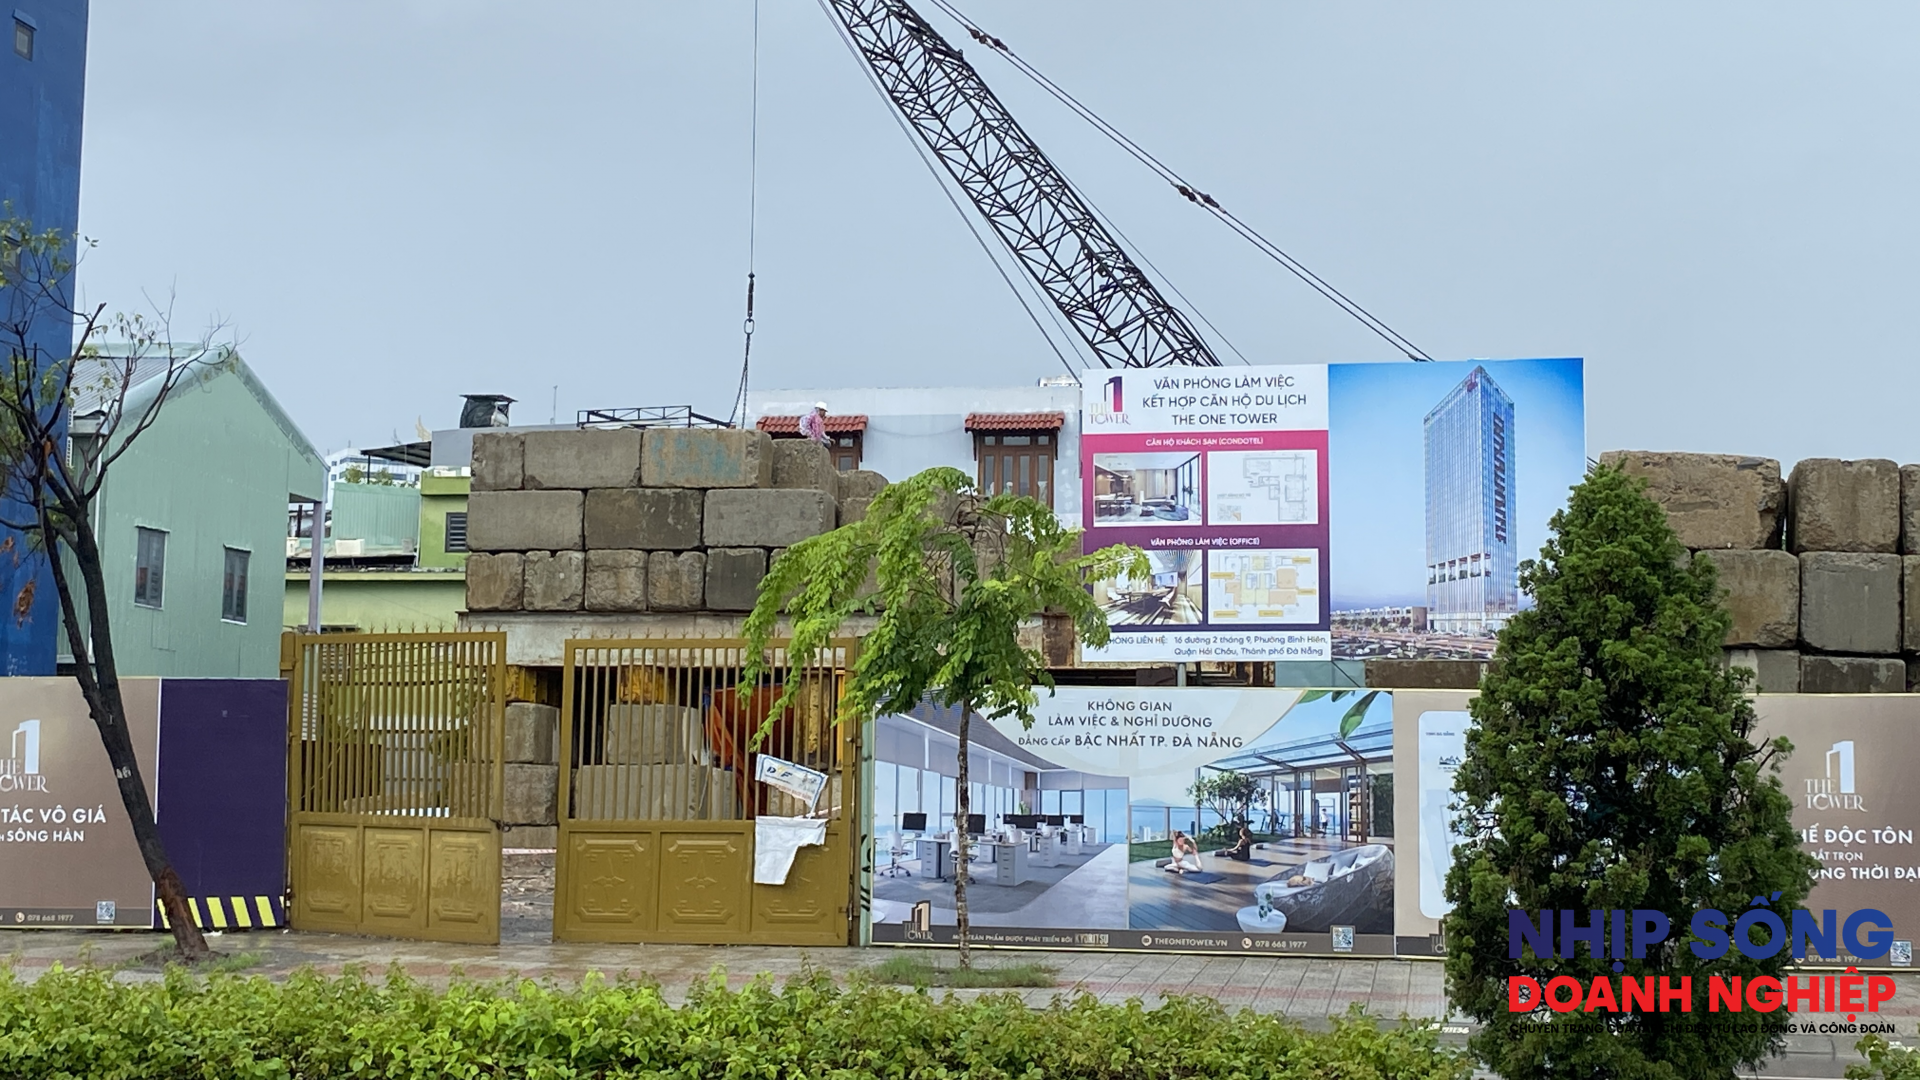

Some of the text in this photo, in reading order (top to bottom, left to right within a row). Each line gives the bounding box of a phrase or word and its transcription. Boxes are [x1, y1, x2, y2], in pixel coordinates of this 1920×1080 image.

[1154, 375, 1295, 390] VĂN PHÒNG LÀM VIỆC
[1143, 394, 1307, 410] KẾT HỢP CĂN HỘ DU LỊCH
[1089, 413, 1131, 425] TOWER
[1172, 413, 1277, 426] THE ONE TOWER
[1218, 436, 1264, 445] (CONDOTEL)
[1230, 537, 1260, 546] (OFFICE)
[1174, 636, 1182, 644] 16
[1220, 636, 1244, 645] tháng
[1246, 636, 1252, 644] 9,
[1174, 648, 1197, 657] Quận
[1087, 698, 1173, 711] KHÔNG GIAN
[1048, 714, 1213, 728] LÀM VIỆC & NGHỈ DƯỠNG
[1050, 734, 1070, 746] CẤP
[1075, 732, 1101, 749] BẬC
[1106, 730, 1145, 747] NHẤT
[1172, 733, 1192, 747] ĐÀ
[1197, 731, 1243, 748] NẴNG
[0, 758, 21, 775] HE
[0, 774, 50, 793] OWER
[1804, 778, 1838, 794] THE
[1804, 793, 1868, 812] TOWER
[1, 803, 107, 824] TÁC VÔ GIÁ
[6, 828, 49, 842] SÔNG
[53, 828, 85, 842] HÀN
[1824, 825, 1867, 847] ĐỘC
[1872, 826, 1913, 844] TÔN
[1833, 851, 1863, 863] TRỌN
[1850, 863, 1889, 880] THỜI
[27, 914, 40, 922] 078
[1154, 937, 1308, 949] THEONETOWER.VN 078 668 1977
